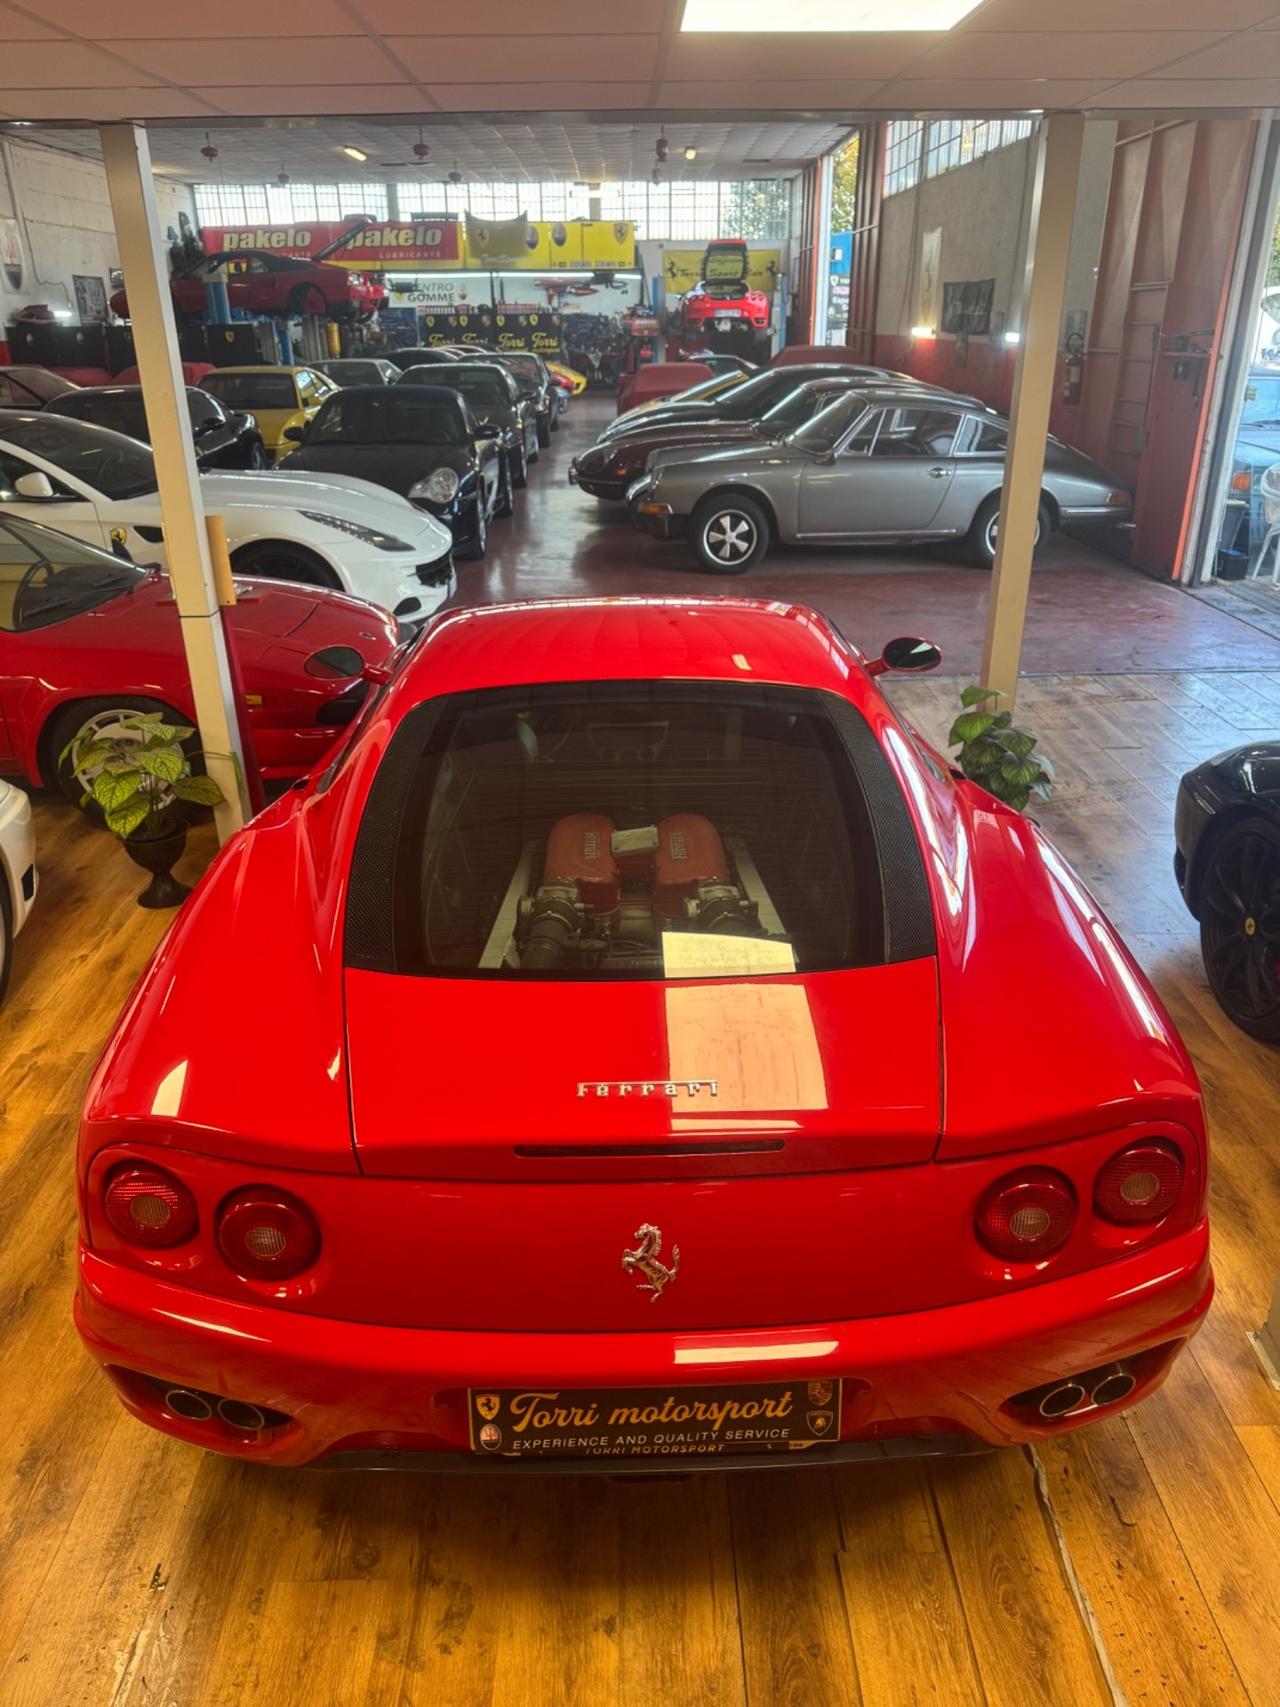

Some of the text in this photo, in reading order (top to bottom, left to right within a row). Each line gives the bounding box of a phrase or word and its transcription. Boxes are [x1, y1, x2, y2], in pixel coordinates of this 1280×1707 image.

[223, 228, 312, 252] pakelo
[417, 282, 454, 292] ENTRO
[407, 292, 456, 302] GOMME
[577, 1080, 718, 1097] Ferrari
[510, 1391, 793, 1433] Torri motorsport
[512, 1428, 792, 1450] EXPERIENCE AND QUALITY SERVICE
[631, 1444, 725, 1454] MOTORSPORT
